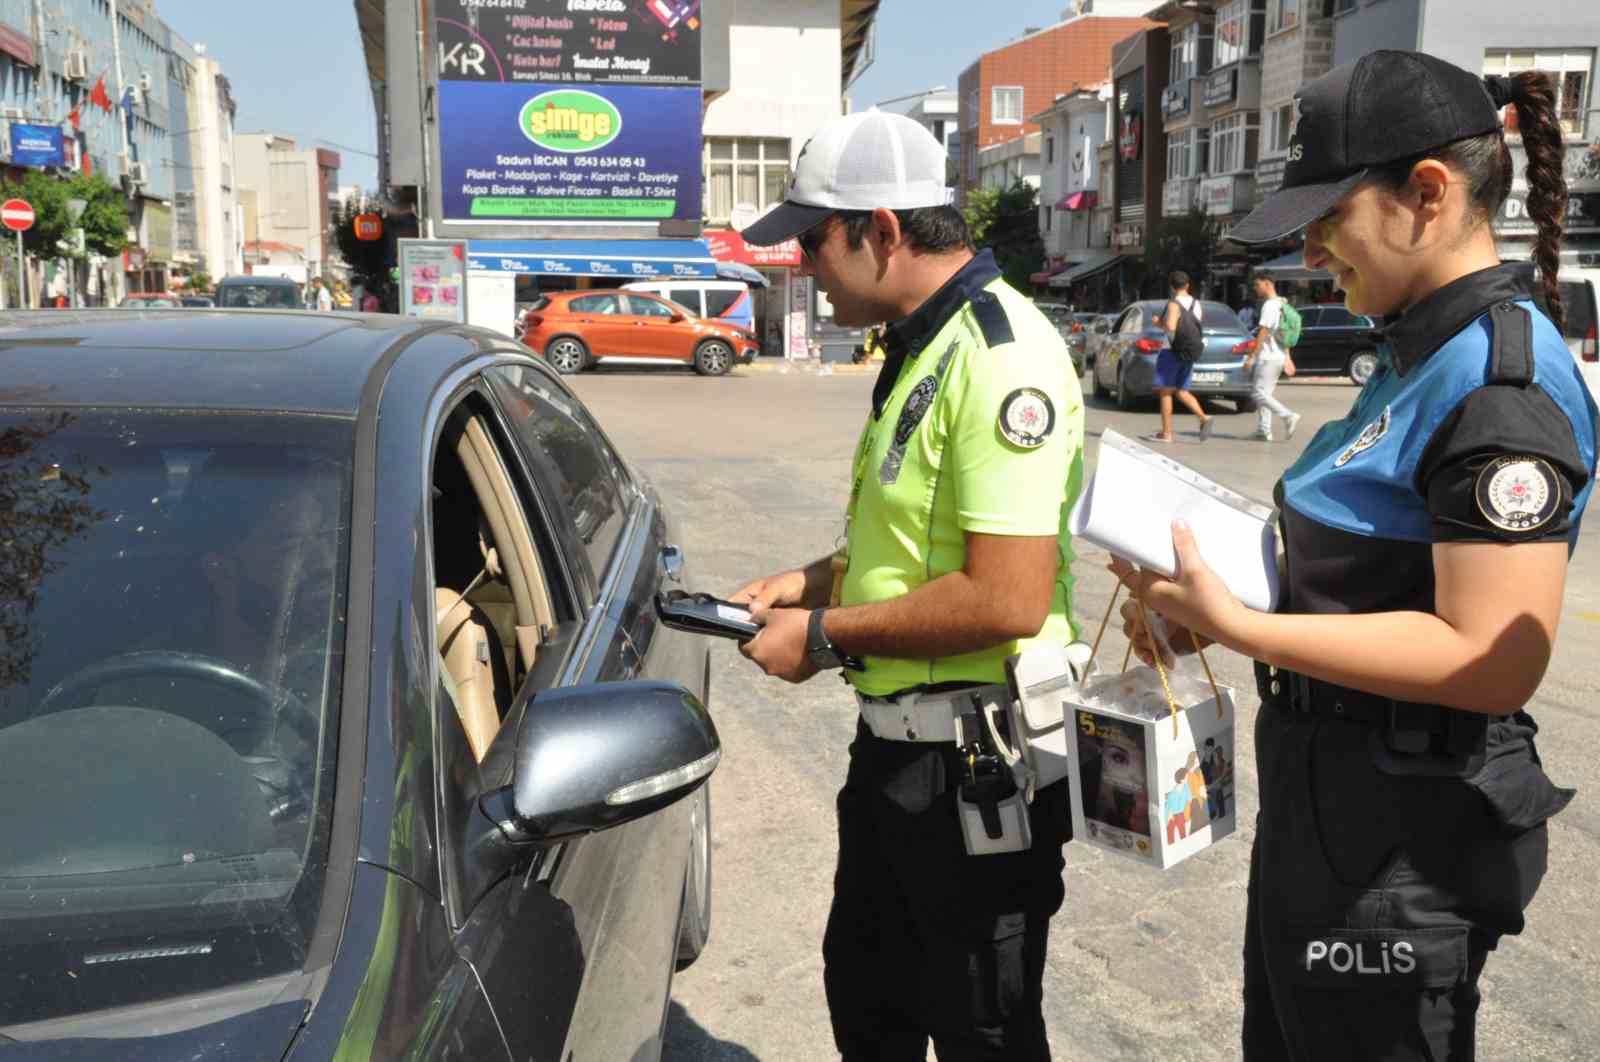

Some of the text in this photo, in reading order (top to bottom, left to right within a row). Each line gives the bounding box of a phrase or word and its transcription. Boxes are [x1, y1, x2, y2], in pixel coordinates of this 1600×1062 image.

[496, 154, 532, 166] Sadun
[574, 156, 598, 167] 0543
[600, 156, 618, 167] 634
[619, 156, 632, 167] 05
[633, 157, 646, 168] 43
[466, 168, 497, 180] Plaket
[638, 171, 679, 184] Davetiye
[462, 184, 488, 196] Kupa
[491, 184, 526, 195] Bardak
[536, 185, 566, 195] Kahve
[644, 186, 676, 197] T-Shirt
